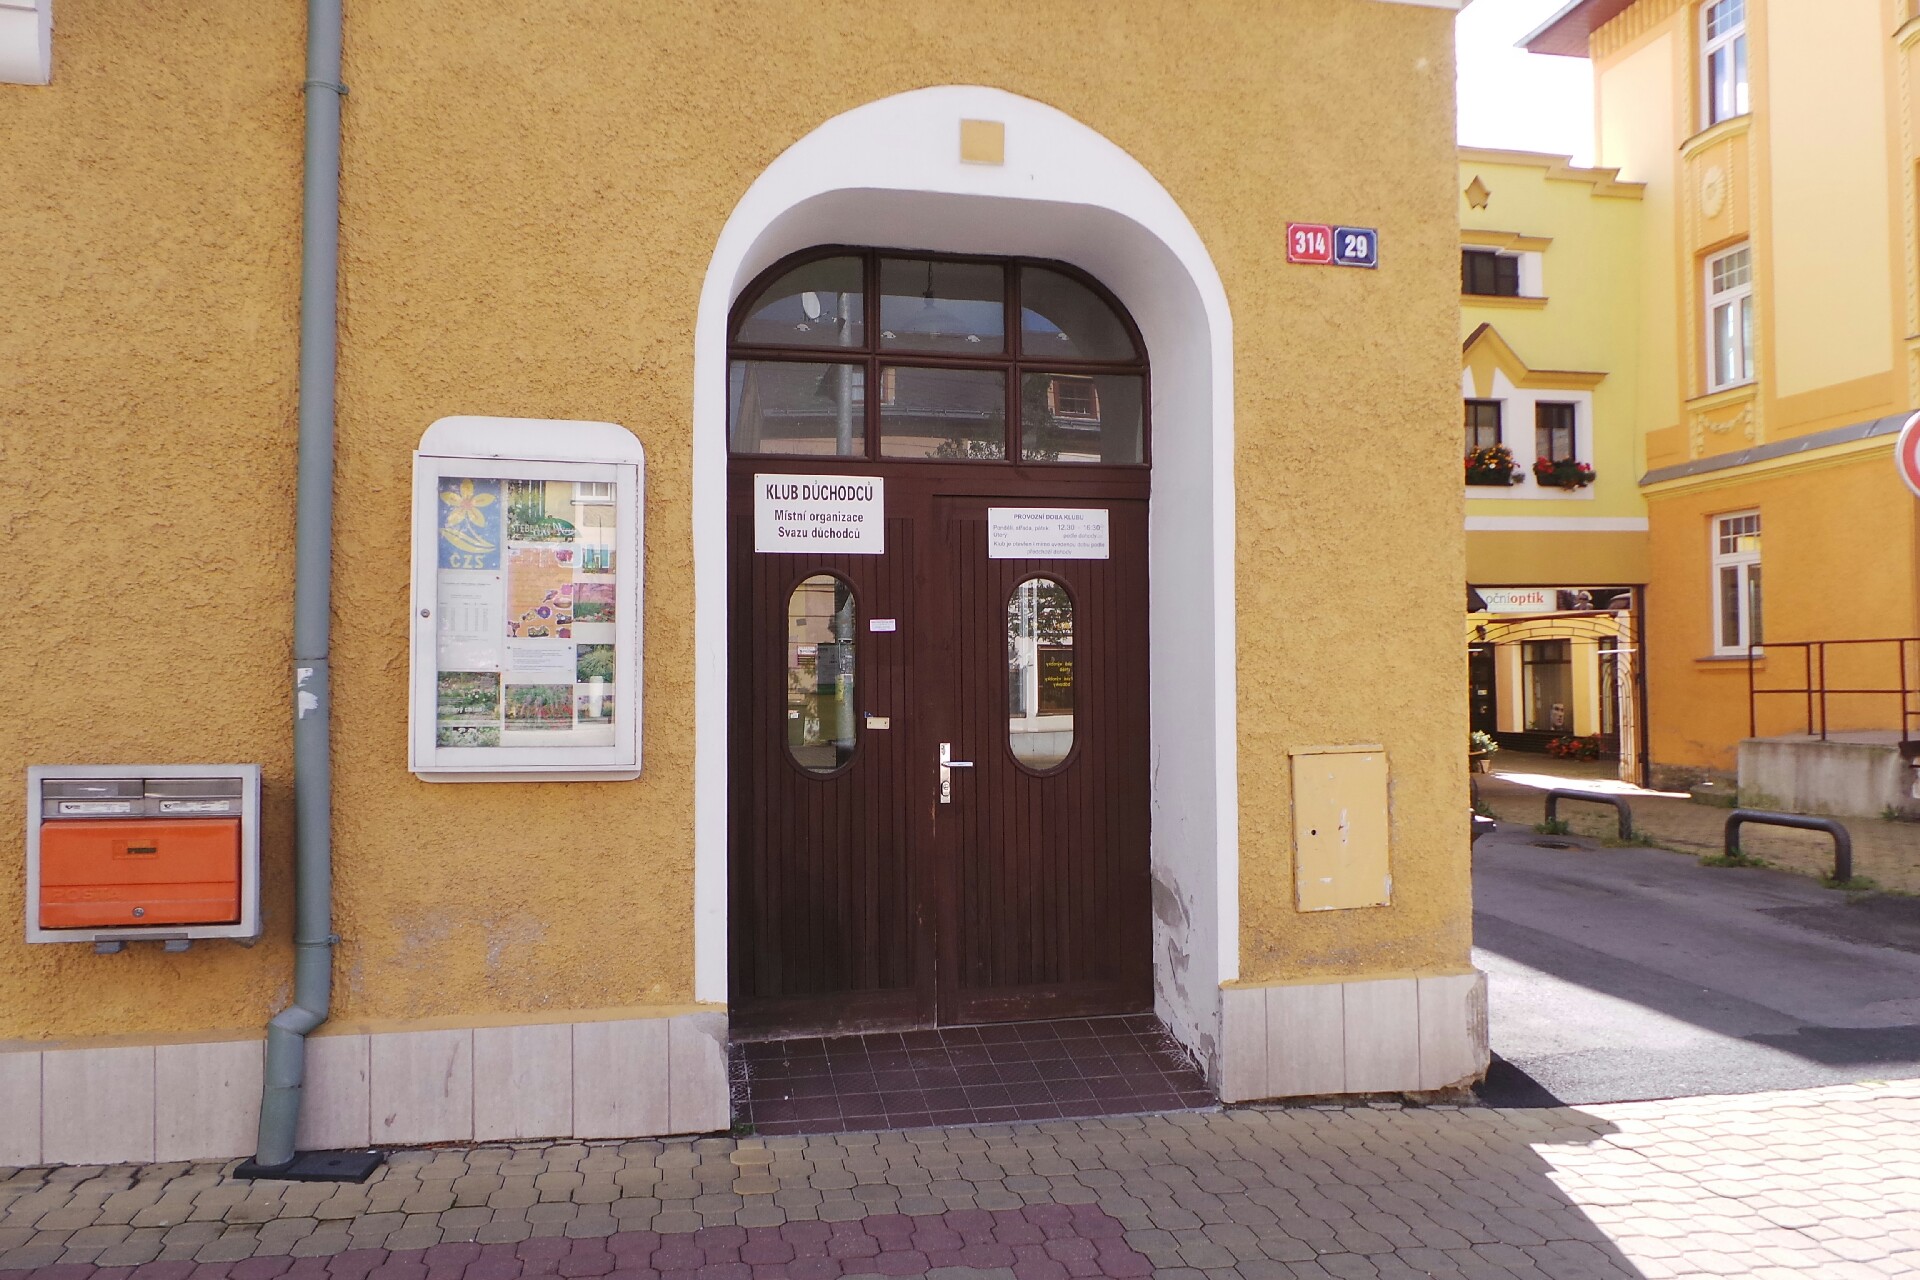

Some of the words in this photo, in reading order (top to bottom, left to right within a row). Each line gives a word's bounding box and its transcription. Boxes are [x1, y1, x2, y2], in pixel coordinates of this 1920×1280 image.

[1295, 230, 1326, 255] 314
[1344, 234, 1368, 259] 29
[766, 483, 799, 500] KLUB
[774, 509, 807, 522] Místní
[809, 511, 864, 524] organizace
[1013, 513, 1045, 521] PROVOZNÍ
[1045, 513, 1063, 521] DOBA
[778, 526, 808, 538] Svazu
[811, 527, 861, 539] důchodců
[449, 553, 485, 569] ČZS
